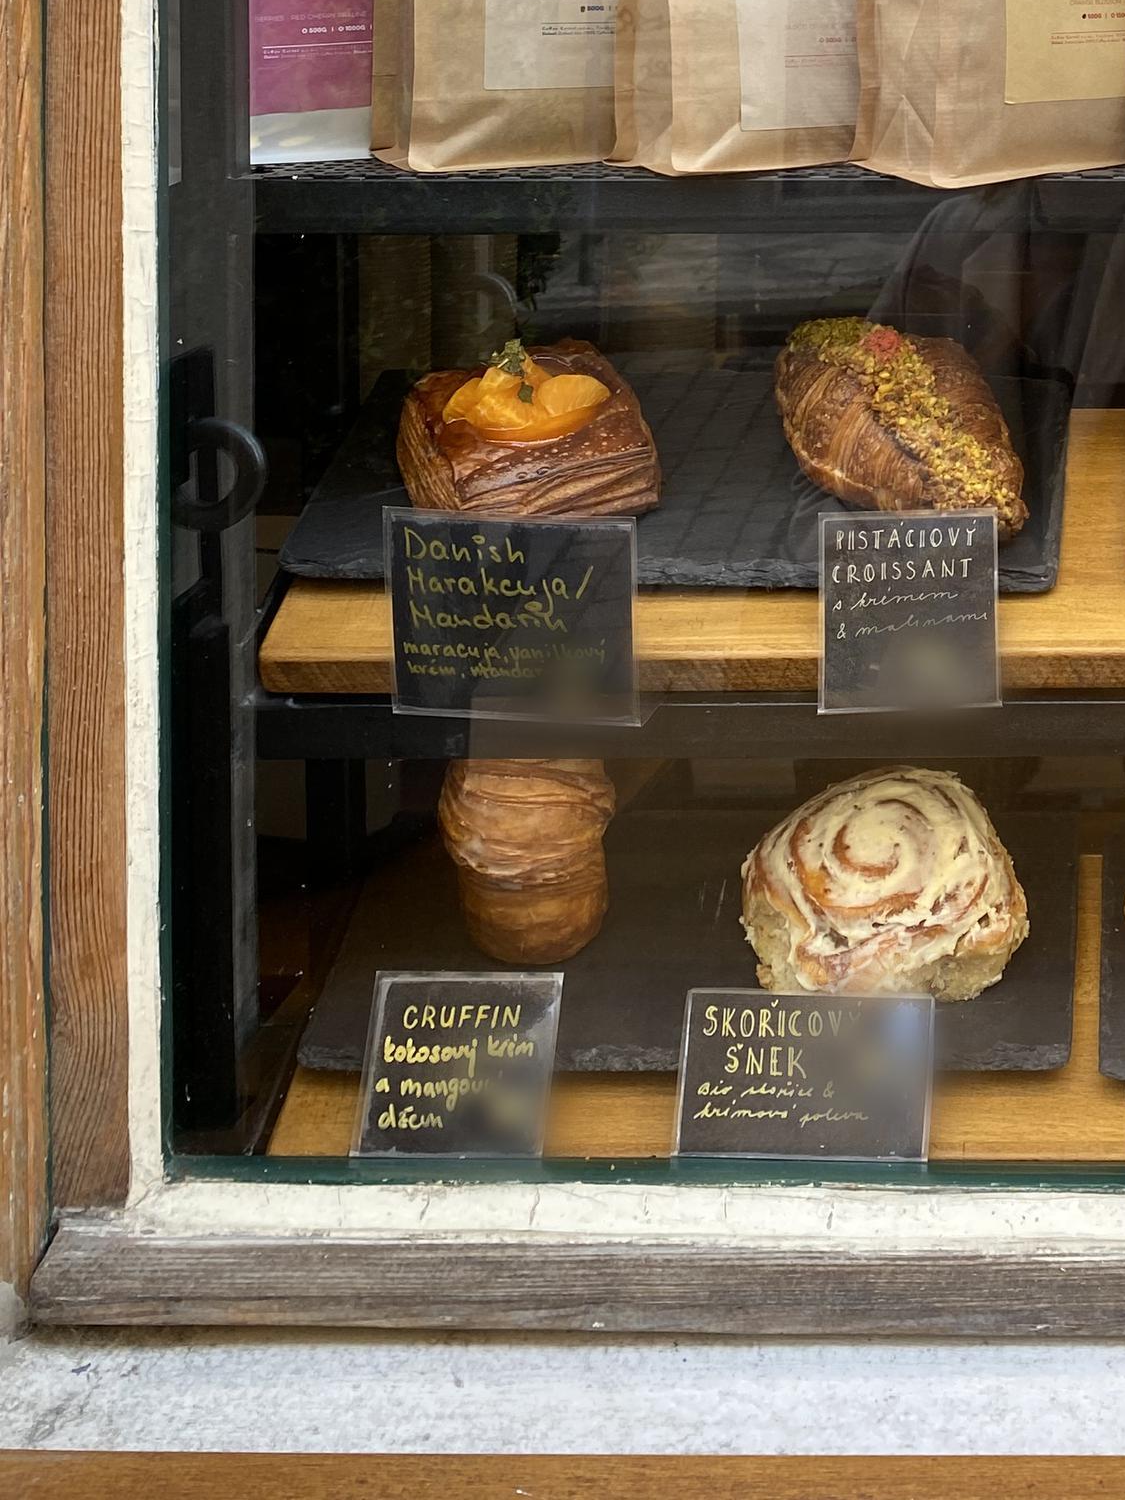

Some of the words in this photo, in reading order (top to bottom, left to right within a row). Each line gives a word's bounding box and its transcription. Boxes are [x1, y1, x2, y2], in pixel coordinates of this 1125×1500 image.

[403, 526, 525, 564] Danish
[836, 520, 977, 550] PISTÁCIOVÝ
[832, 558, 973, 583] CROISSANT
[836, 623, 846, 639] &
[403, 1004, 521, 1030] CRUFFIN
[724, 1043, 807, 1079] ŠNEK
[375, 1077, 390, 1094] a
[822, 1080, 835, 1099] &
